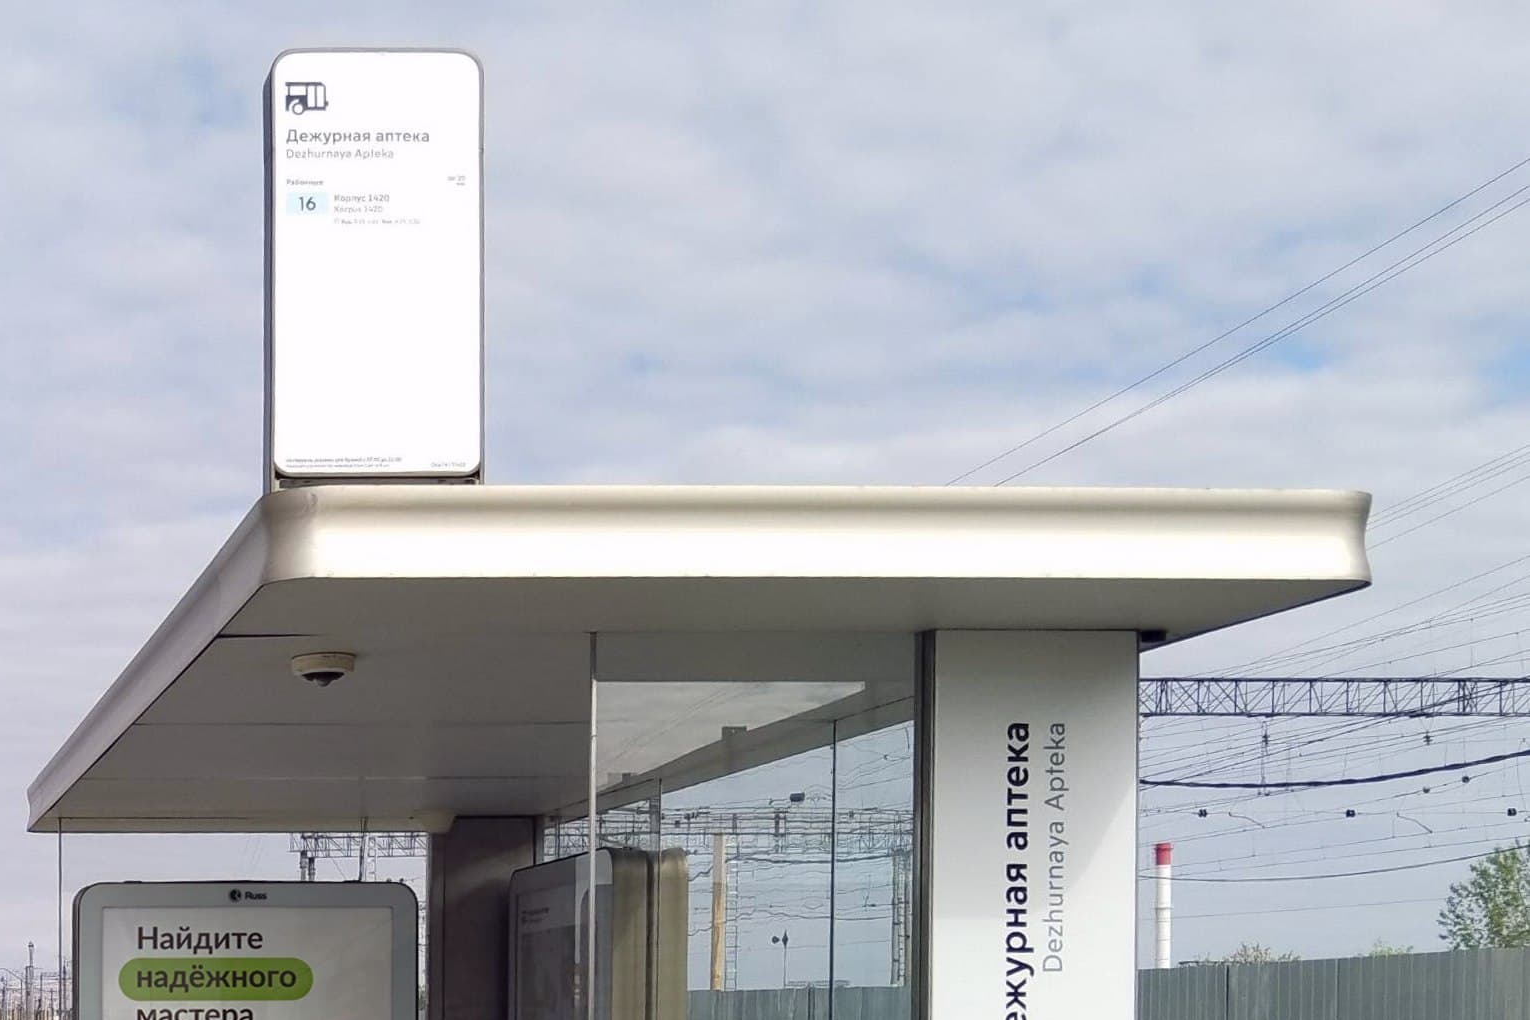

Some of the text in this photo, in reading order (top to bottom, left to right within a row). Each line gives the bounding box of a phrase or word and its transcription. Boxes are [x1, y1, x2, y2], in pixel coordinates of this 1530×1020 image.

[285, 129, 430, 145] Дежурная аптека
[354, 148, 394, 160] Apteka
[299, 196, 317, 212] 16
[1006, 721, 1031, 851] аптека
[1042, 721, 1070, 974] Dezhurnaya Apteka
[244, 891, 268, 900] Russ
[137, 926, 263, 954] Найдите
[136, 964, 297, 993] надёжного
